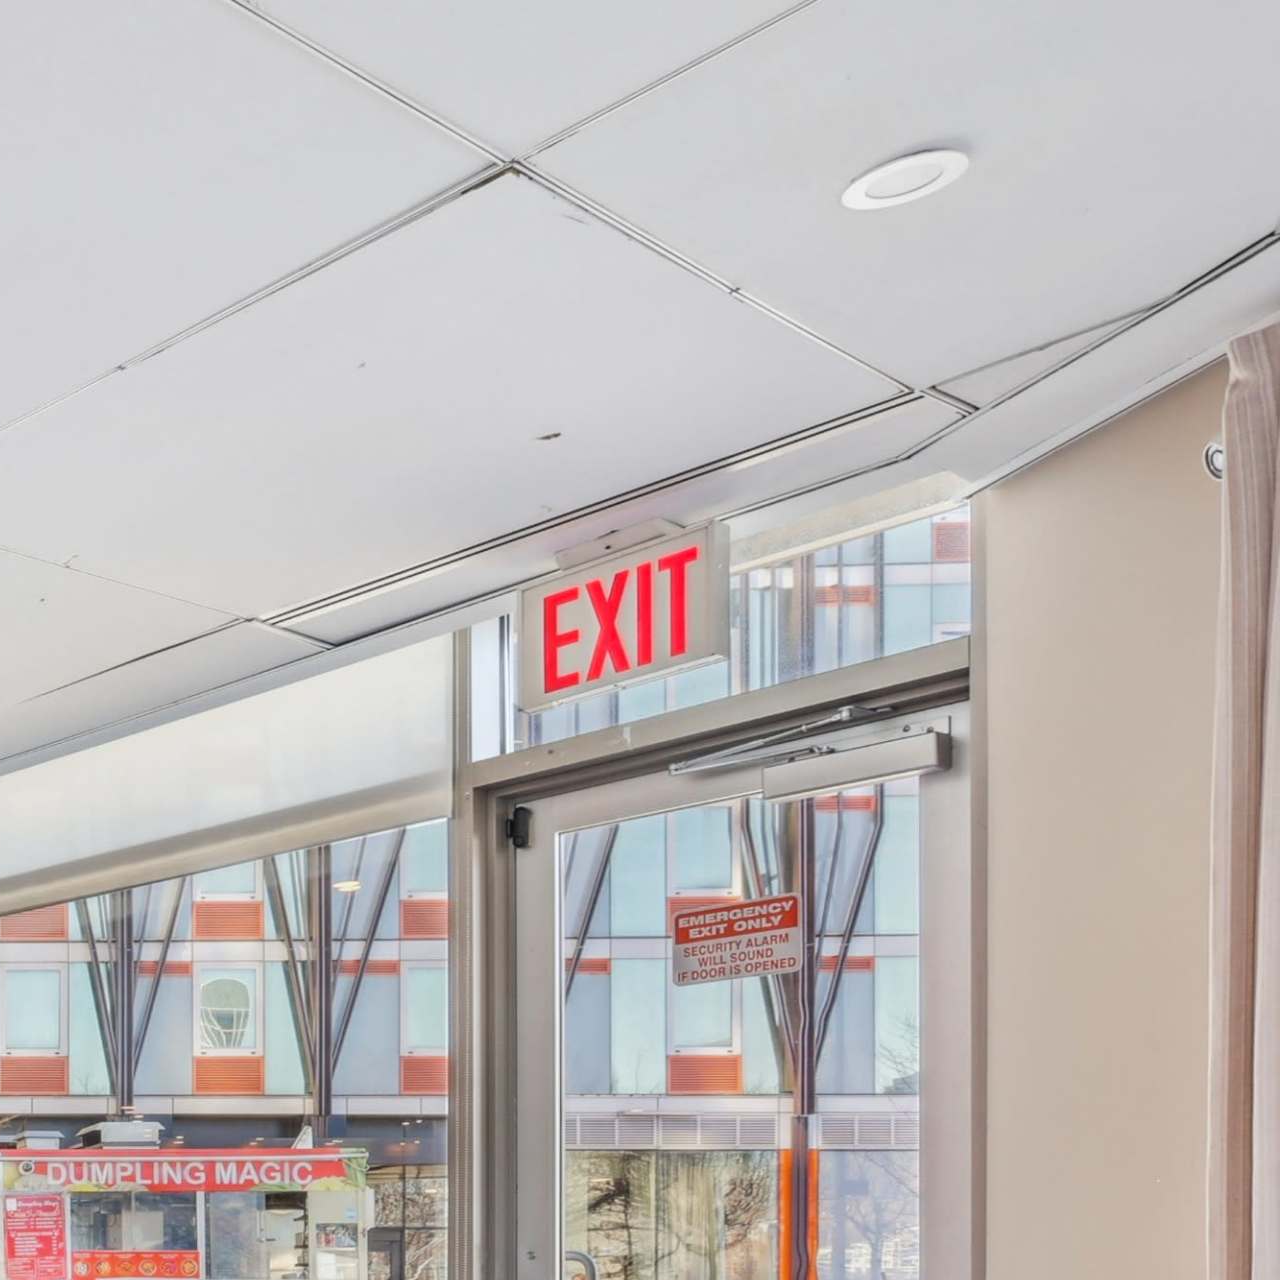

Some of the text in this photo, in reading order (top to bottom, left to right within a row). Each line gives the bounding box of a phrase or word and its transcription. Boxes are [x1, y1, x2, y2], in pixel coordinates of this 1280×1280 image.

[544, 546, 698, 693] EXIT
[678, 900, 794, 928] EMERGENCY
[688, 915, 782, 939] EXIT ONLY
[683, 933, 789, 958] SECURITY ALARM
[697, 948, 774, 968] WILL SOUND
[677, 957, 796, 983] IF DOOR IS OPENED
[46, 1161, 313, 1185] DUMPLING MAGIC
